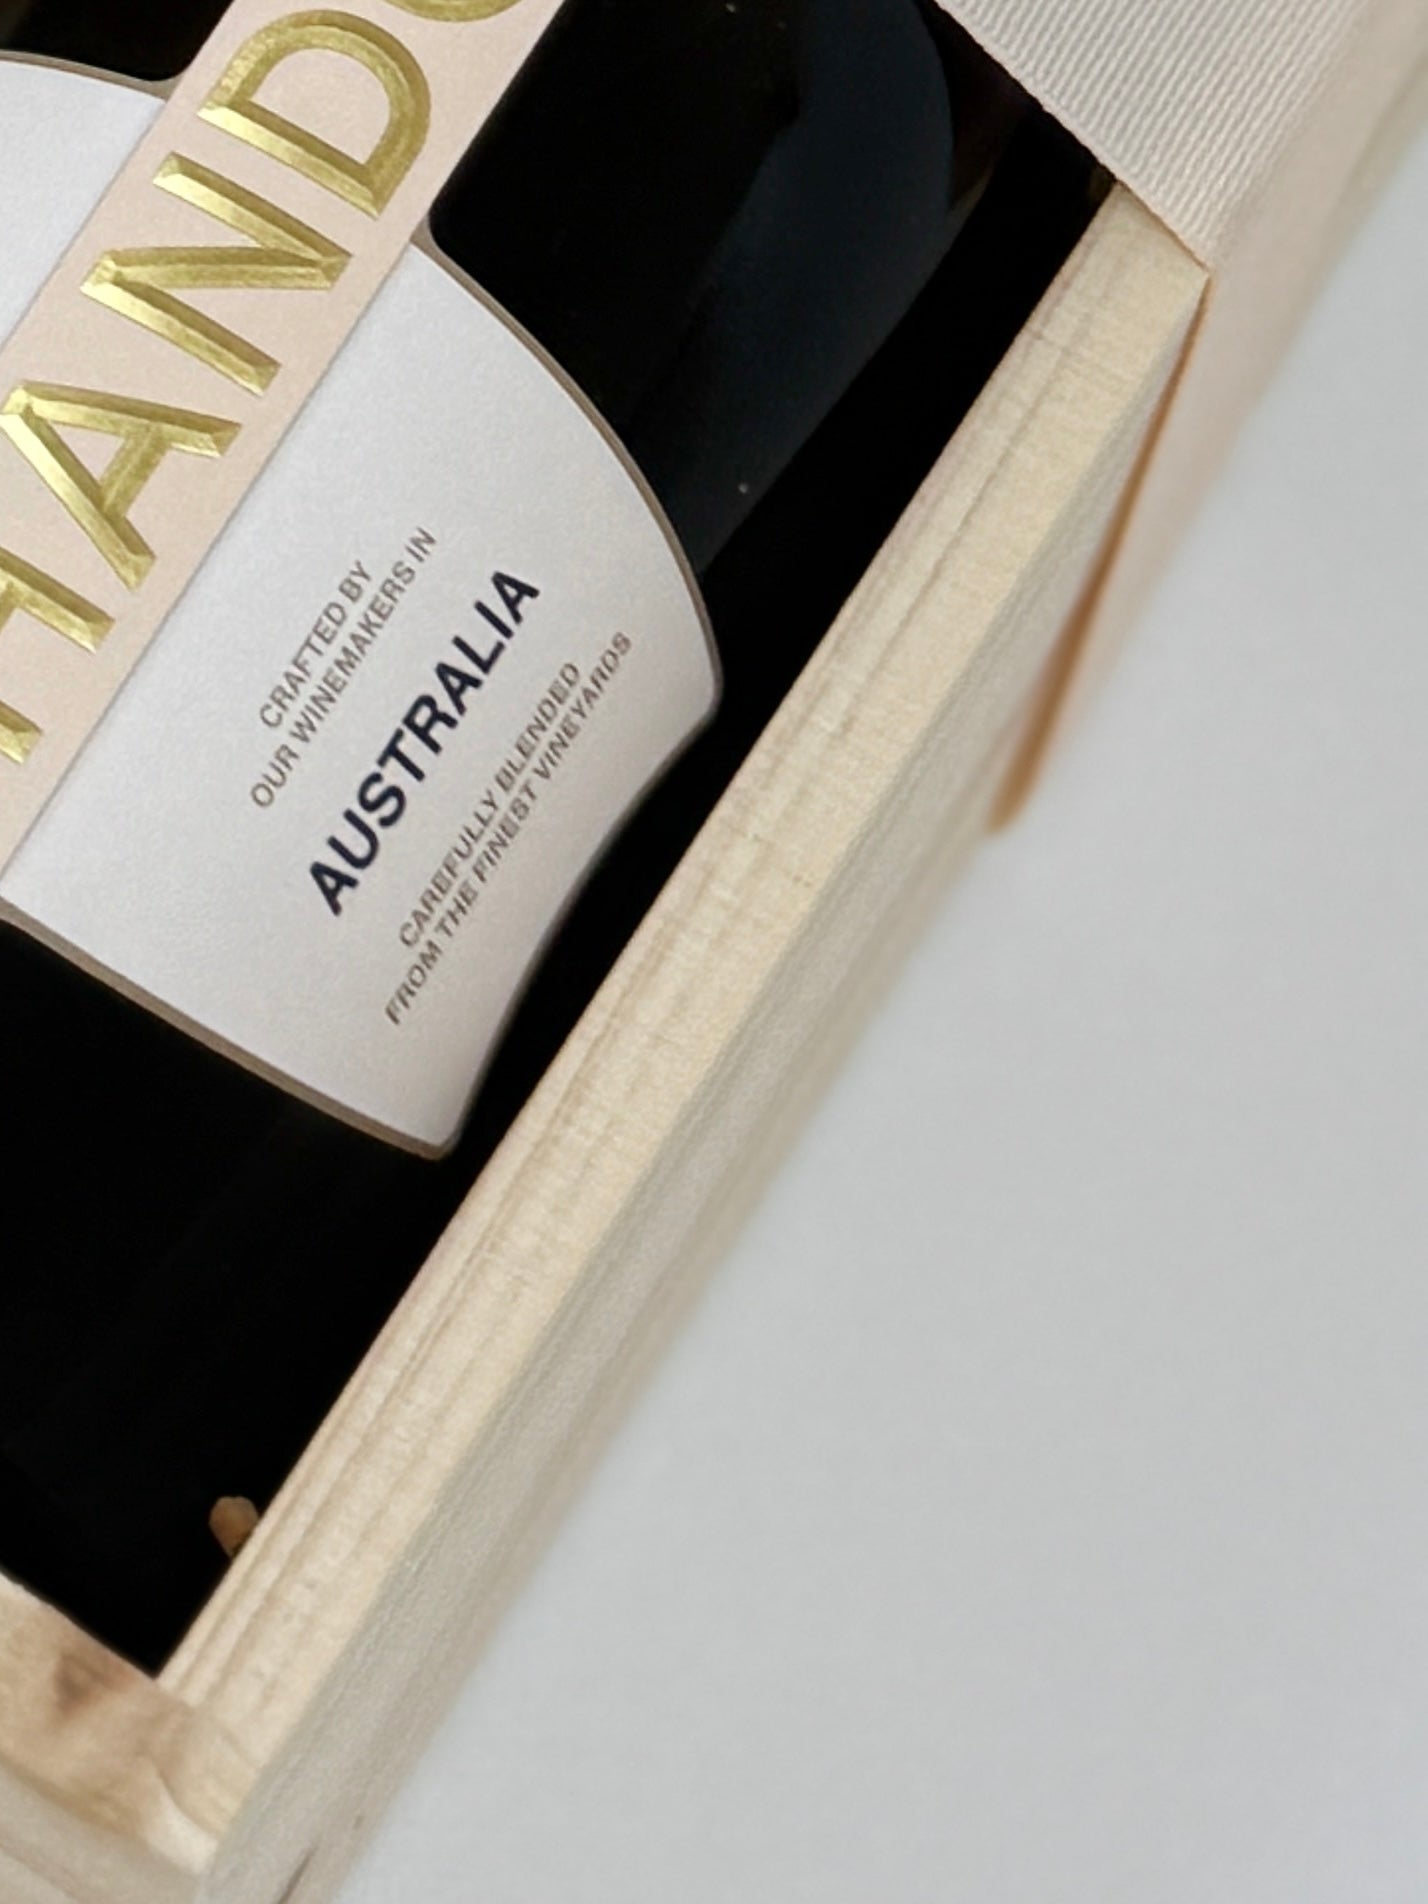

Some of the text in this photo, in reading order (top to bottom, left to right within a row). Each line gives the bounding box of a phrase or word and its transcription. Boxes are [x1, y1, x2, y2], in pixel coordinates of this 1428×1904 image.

[250, 527, 437, 808] OUR WINEMAKERS IN
[259, 559, 372, 728] CRAFTED BY
[308, 570, 540, 916] AUSTRALIA
[385, 631, 632, 1026] FROM THE FINEST VINEYARDS
[399, 662, 581, 949] CAREFULLY BLENDED
